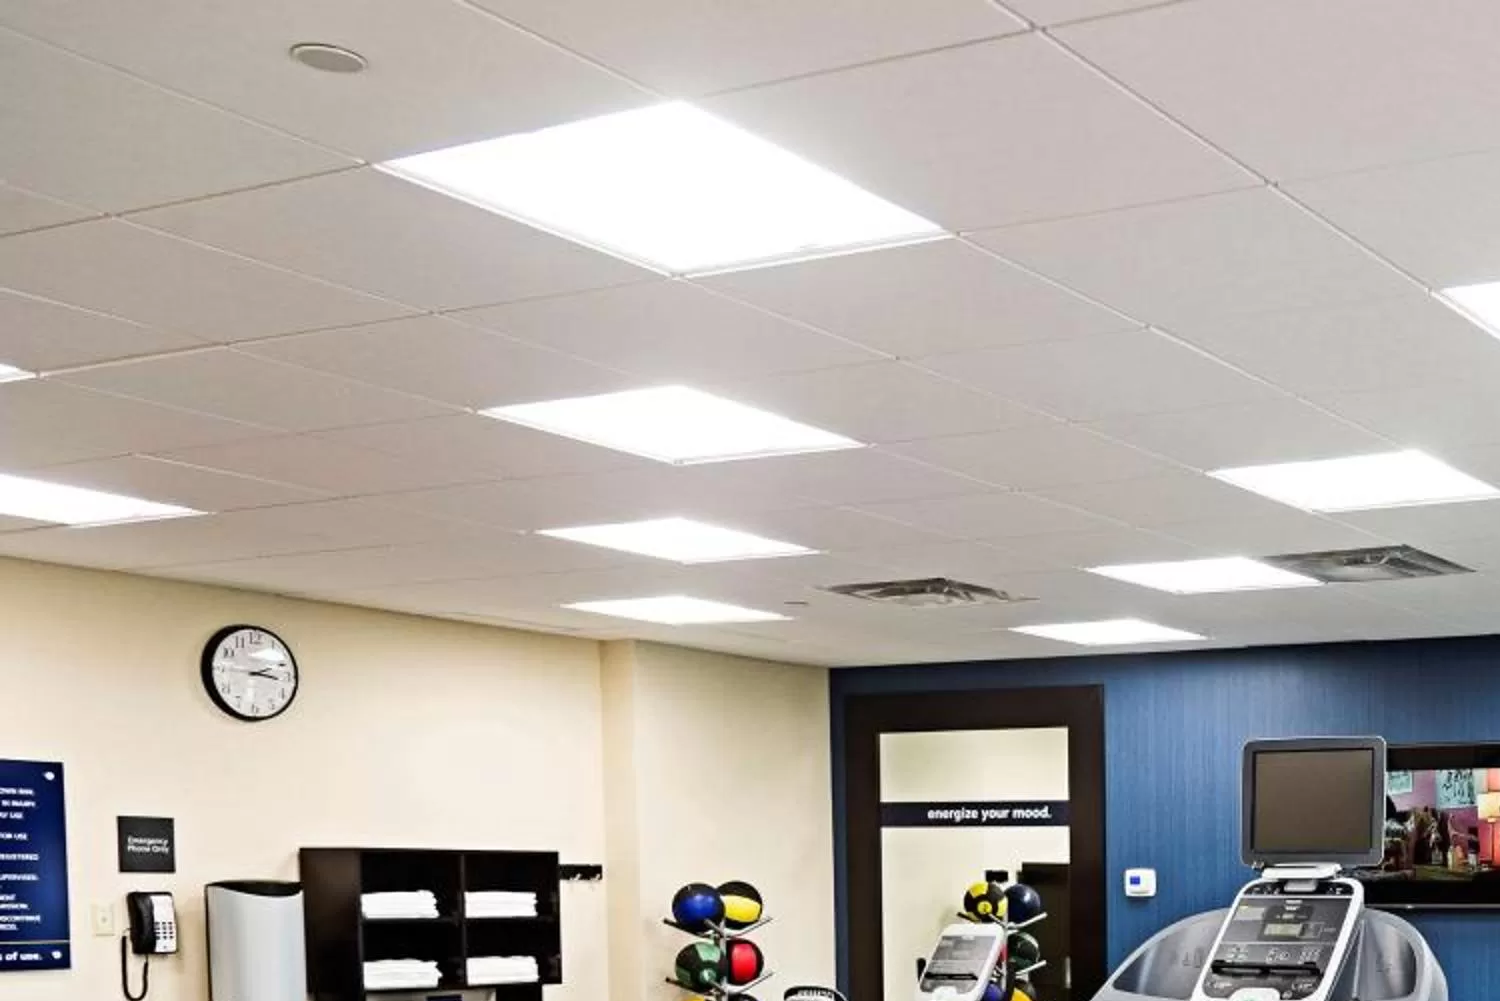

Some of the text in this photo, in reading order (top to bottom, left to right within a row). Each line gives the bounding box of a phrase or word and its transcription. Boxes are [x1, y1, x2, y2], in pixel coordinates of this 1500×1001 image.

[927, 805, 1052, 823] energize your mood.
[127, 836, 169, 846] Emergency
[151, 845, 169, 854] Only
[5, 951, 18, 960] of
